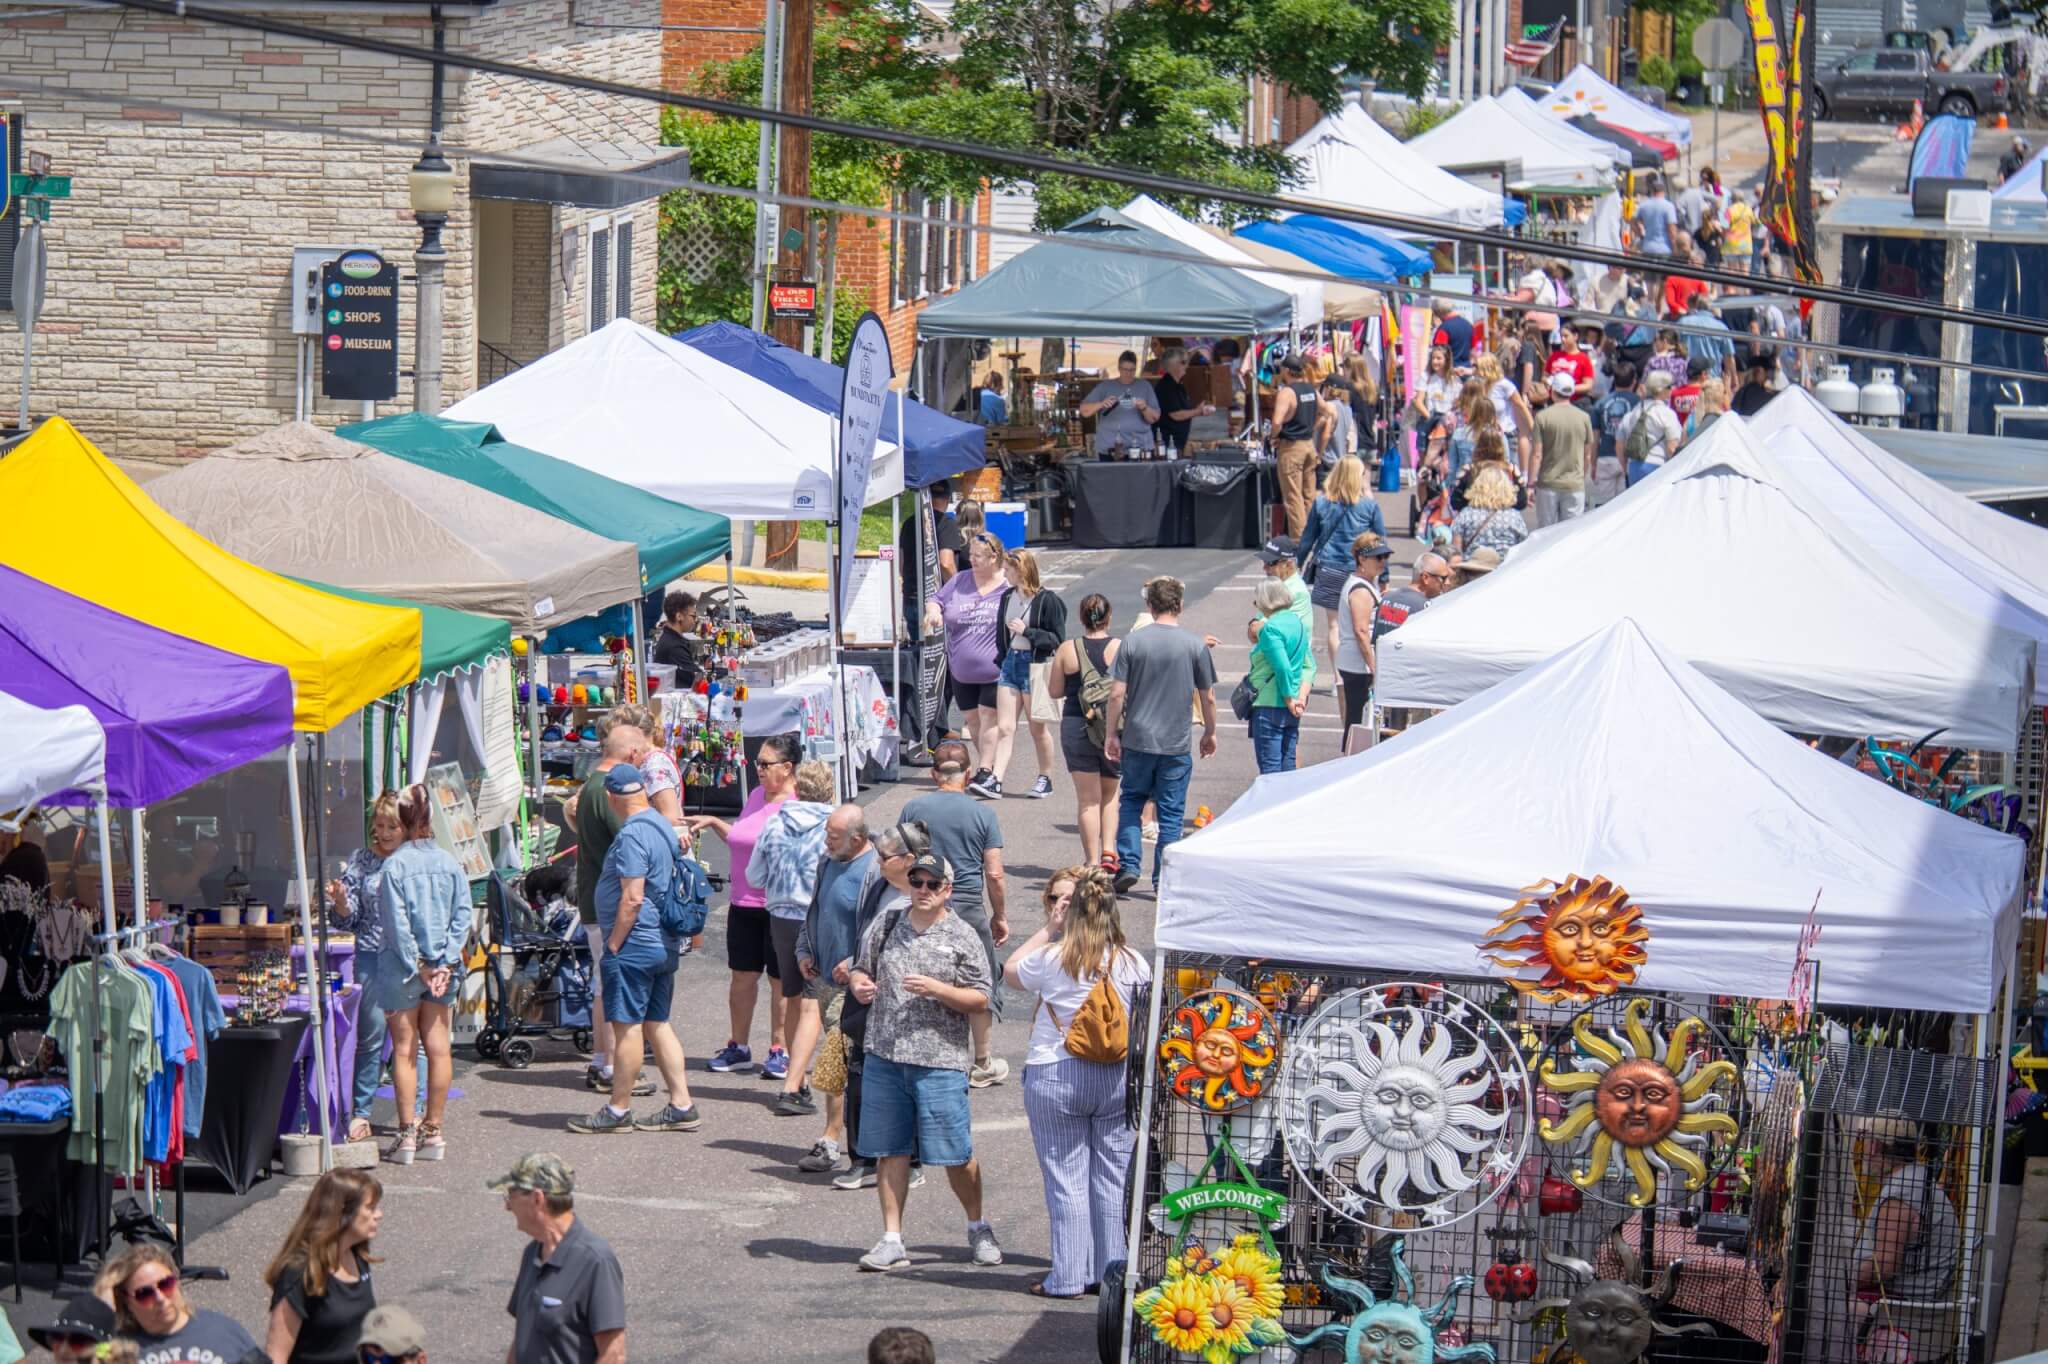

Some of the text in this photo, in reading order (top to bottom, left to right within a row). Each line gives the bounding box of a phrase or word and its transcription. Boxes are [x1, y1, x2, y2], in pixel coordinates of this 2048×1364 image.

[344, 285, 392, 297] FOOD-DRINK
[344, 311, 382, 323] SHOPS
[344, 338, 392, 350] MUSEUM
[1175, 1188, 1265, 1211] WELCOME
[138, 1346, 182, 1364] OAT
